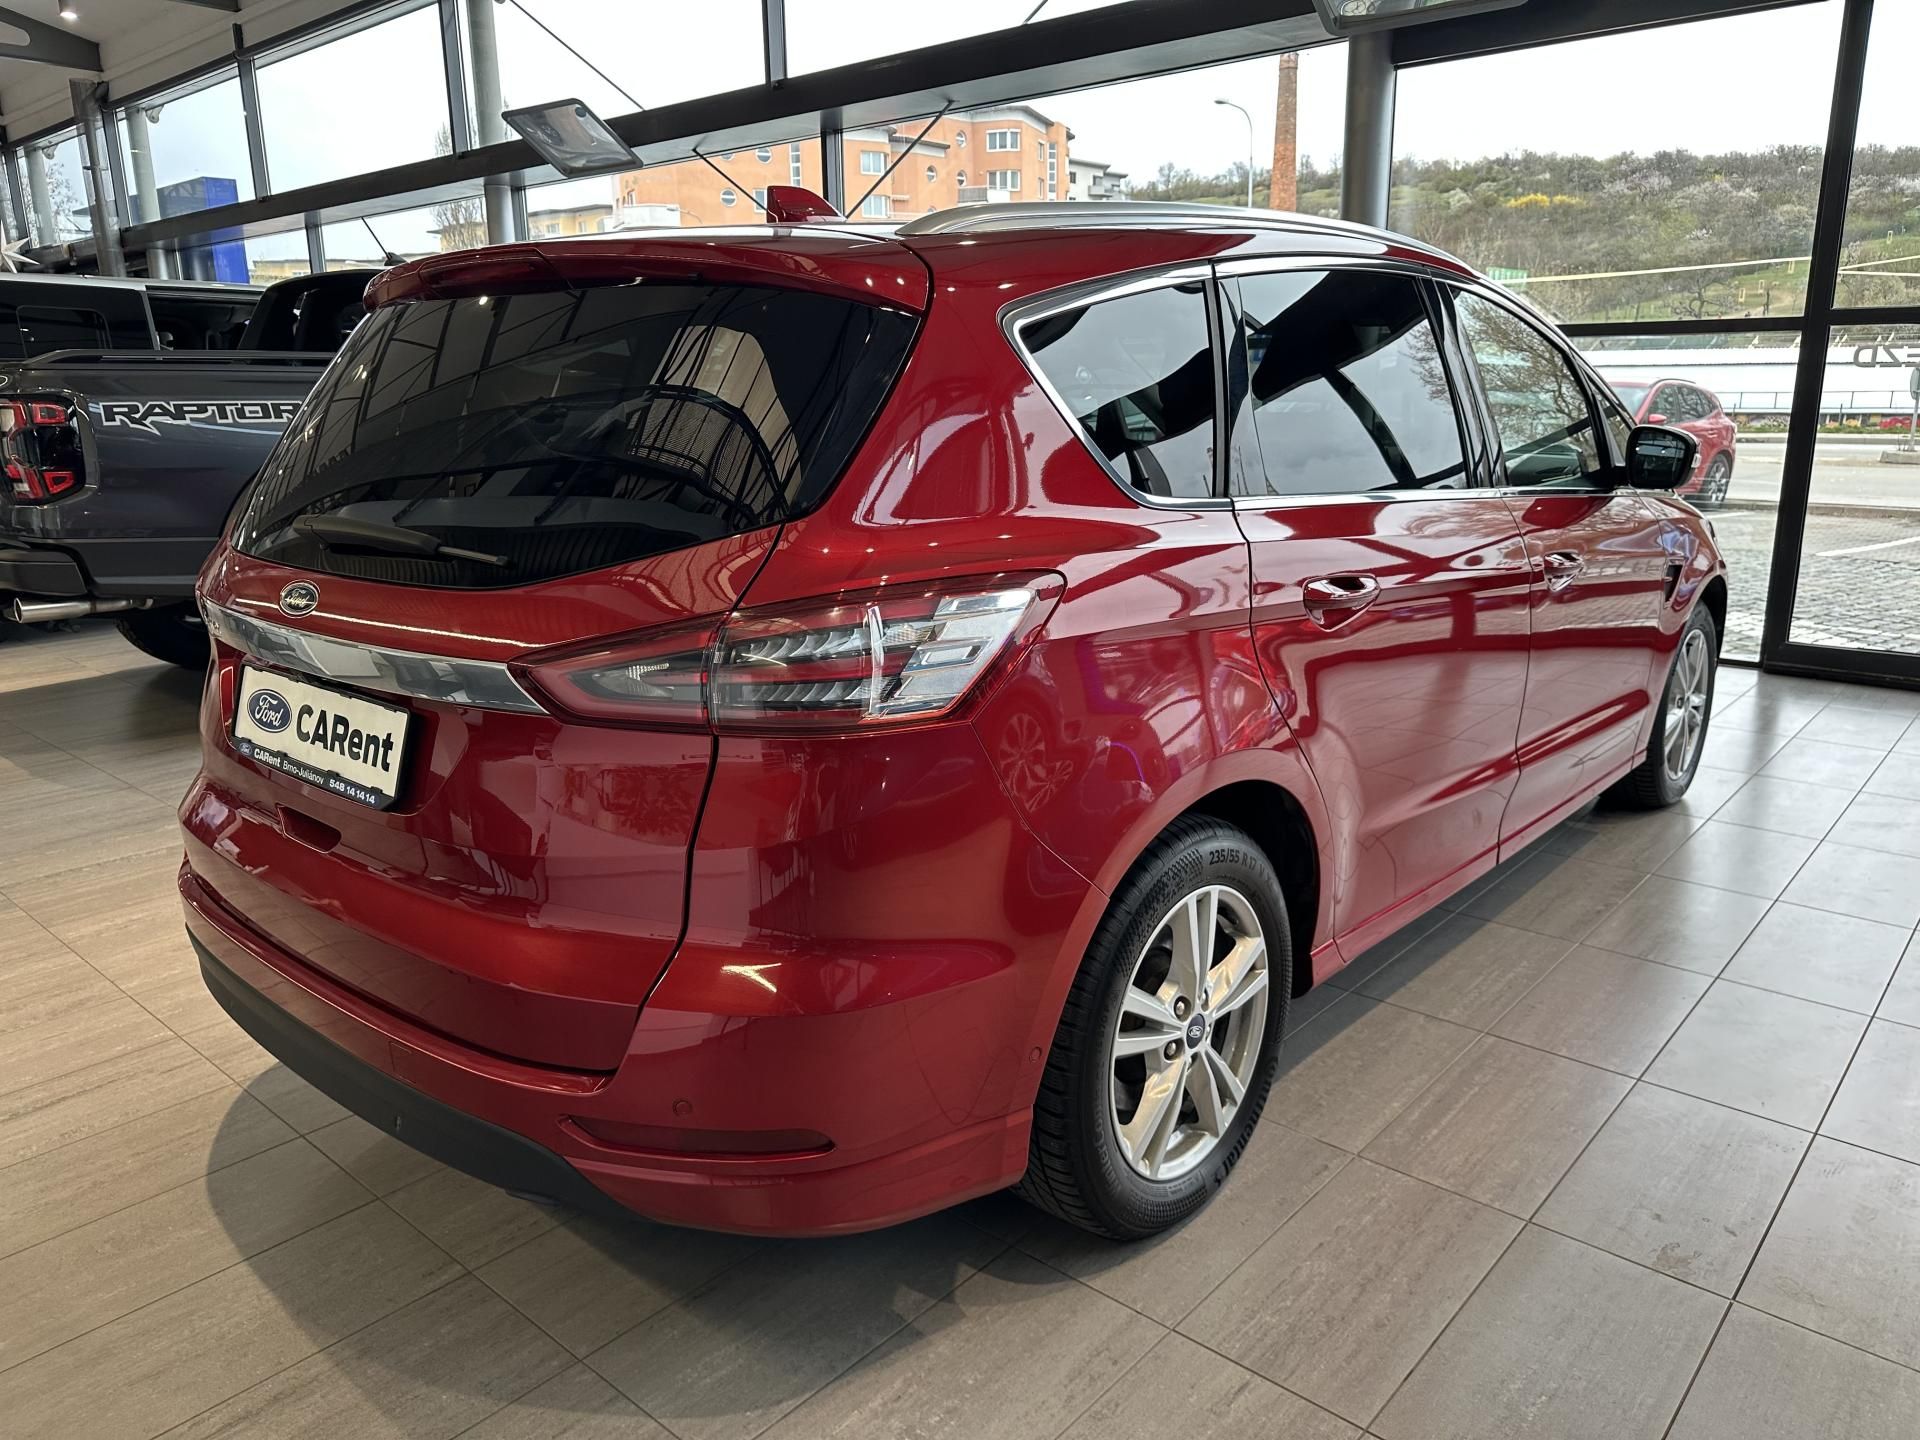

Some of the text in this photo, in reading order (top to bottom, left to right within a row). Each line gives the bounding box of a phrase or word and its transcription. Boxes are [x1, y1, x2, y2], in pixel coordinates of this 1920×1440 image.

[100, 401, 302, 436] RAPTOR
[254, 694, 394, 772] Ford CARent
[254, 748, 281, 767] CARent
[283, 760, 325, 784] Brno-Juliánov
[329, 778, 345, 792] 548
[1209, 848, 1240, 866] 235/55
